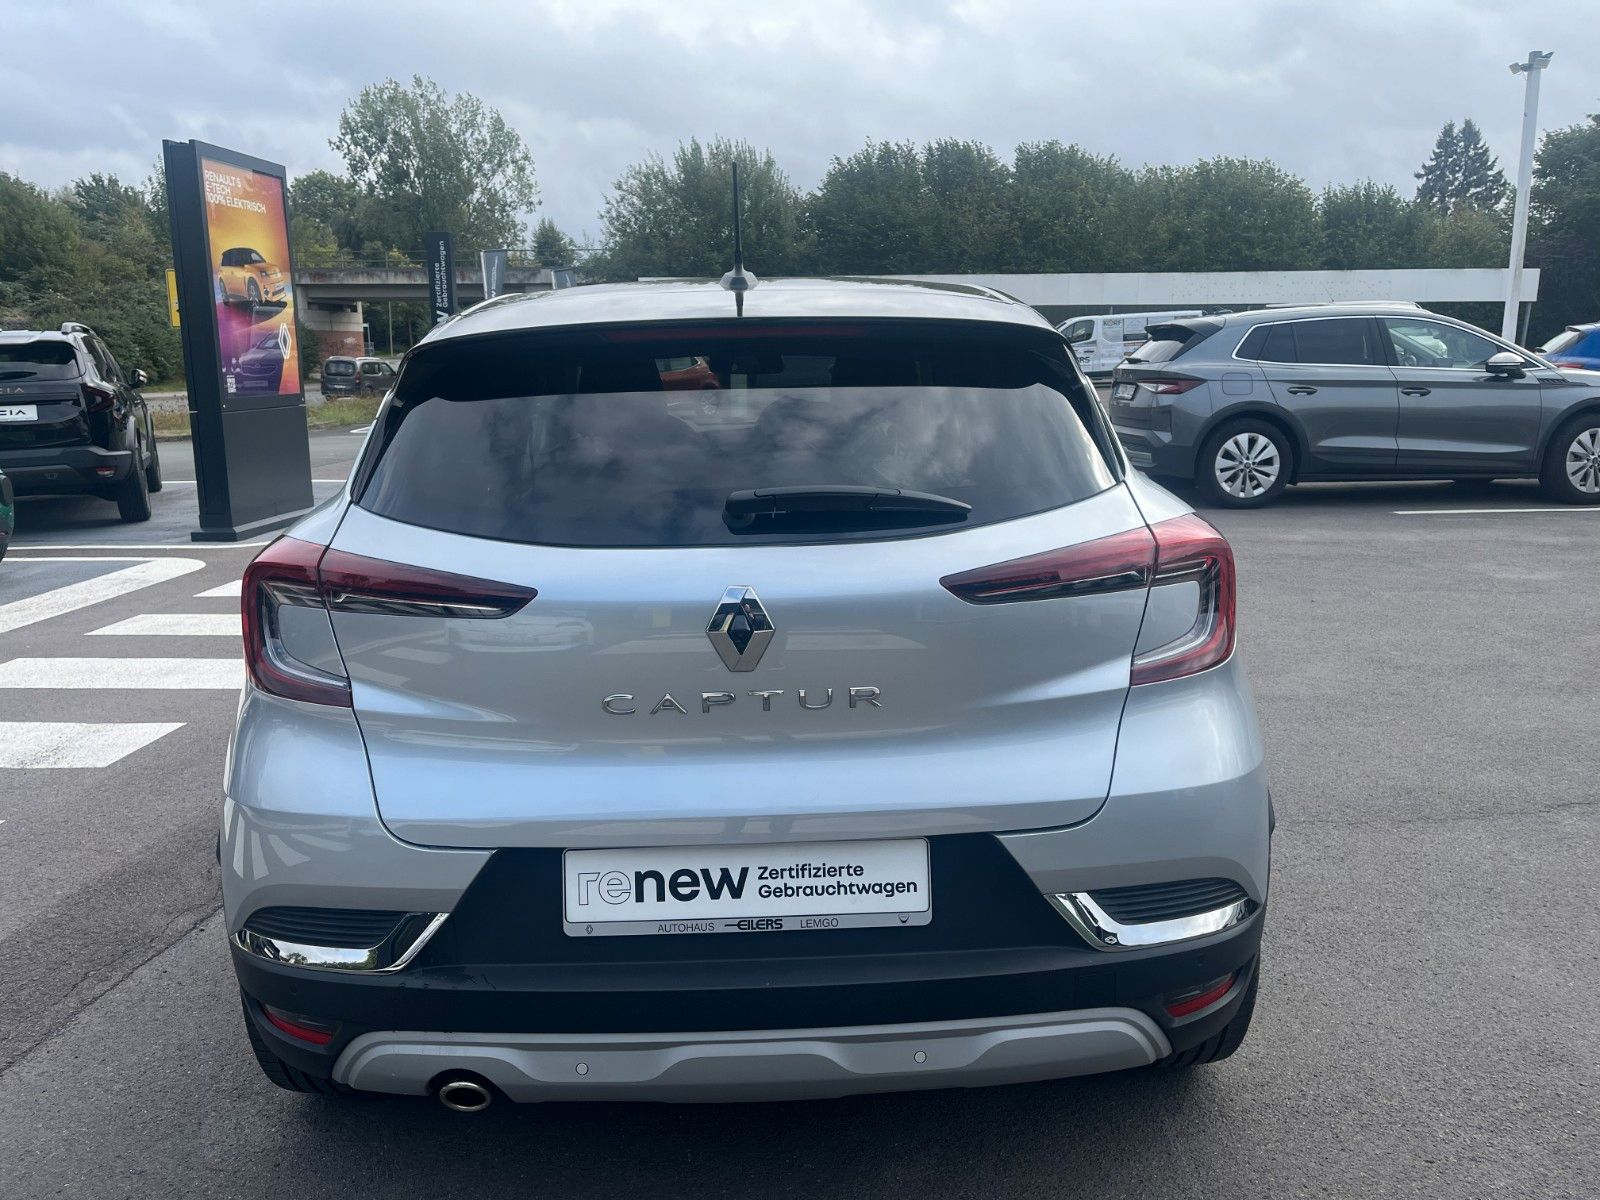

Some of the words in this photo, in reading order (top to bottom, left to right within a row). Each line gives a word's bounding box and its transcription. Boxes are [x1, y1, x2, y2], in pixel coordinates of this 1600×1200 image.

[205, 170, 236, 186] RENAULT
[206, 192, 226, 205] 100%
[226, 196, 267, 214] ELEKTRISCH
[439, 240, 449, 308] Gebrauchtwagen
[602, 686, 883, 716] CAPTUR
[757, 863, 865, 881] Zertifizierte
[577, 866, 750, 906] renew
[758, 880, 918, 899] Gebrauchtwagen
[657, 922, 715, 933] AUTOHAUS
[735, 918, 783, 931] EILERS
[799, 917, 839, 929] LEMGO
